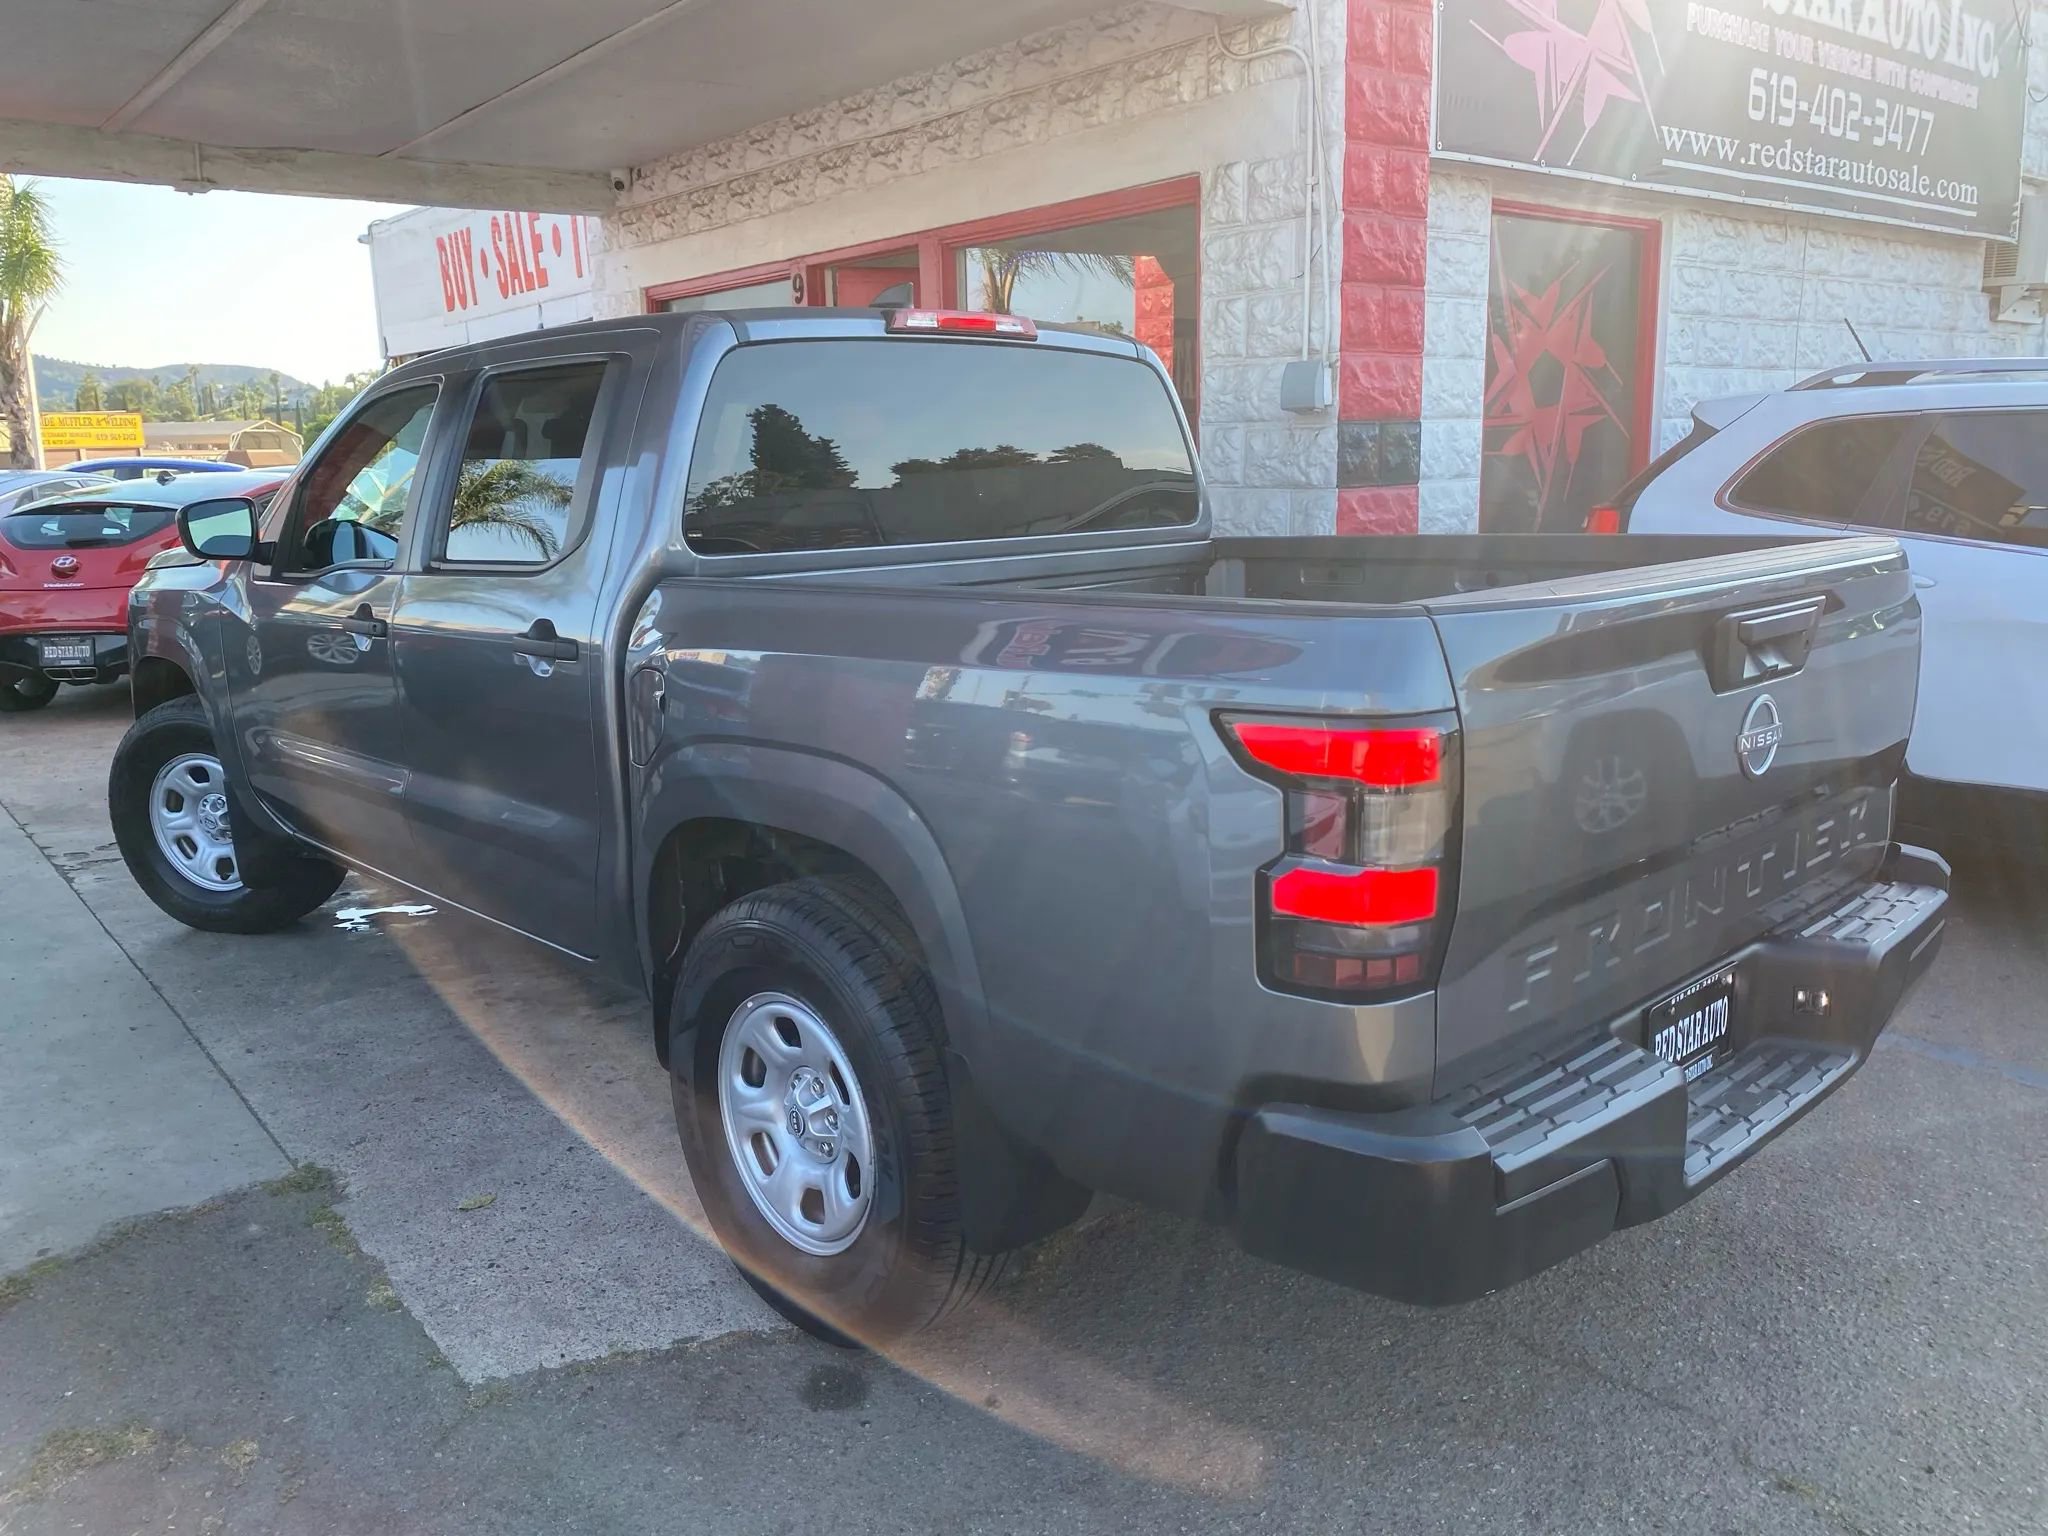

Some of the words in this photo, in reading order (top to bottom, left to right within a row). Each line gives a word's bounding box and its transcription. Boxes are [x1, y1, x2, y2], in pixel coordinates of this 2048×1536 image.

[1686, 2, 1770, 53] PURCHASE
[1774, 27, 1815, 64] YOUR
[1748, 67, 1935, 156] 619-402-3477
[1660, 125, 1978, 205] www.redstarautosale.com
[435, 226, 479, 313] BUY
[490, 211, 549, 300] SALE
[792, 272, 804, 304] 9
[58, 416, 93, 427] MUFFLER
[44, 646, 57, 658] RED
[57, 646, 73, 658] STAR
[74, 645, 91, 658] AUTO
[1740, 726, 1783, 750] NISSAN
[1508, 798, 1869, 1012] FRONTIER
[1655, 1025, 1676, 1063] RED
[1676, 1008, 1703, 1062] STAR
[1702, 995, 1729, 1046] AUTO
